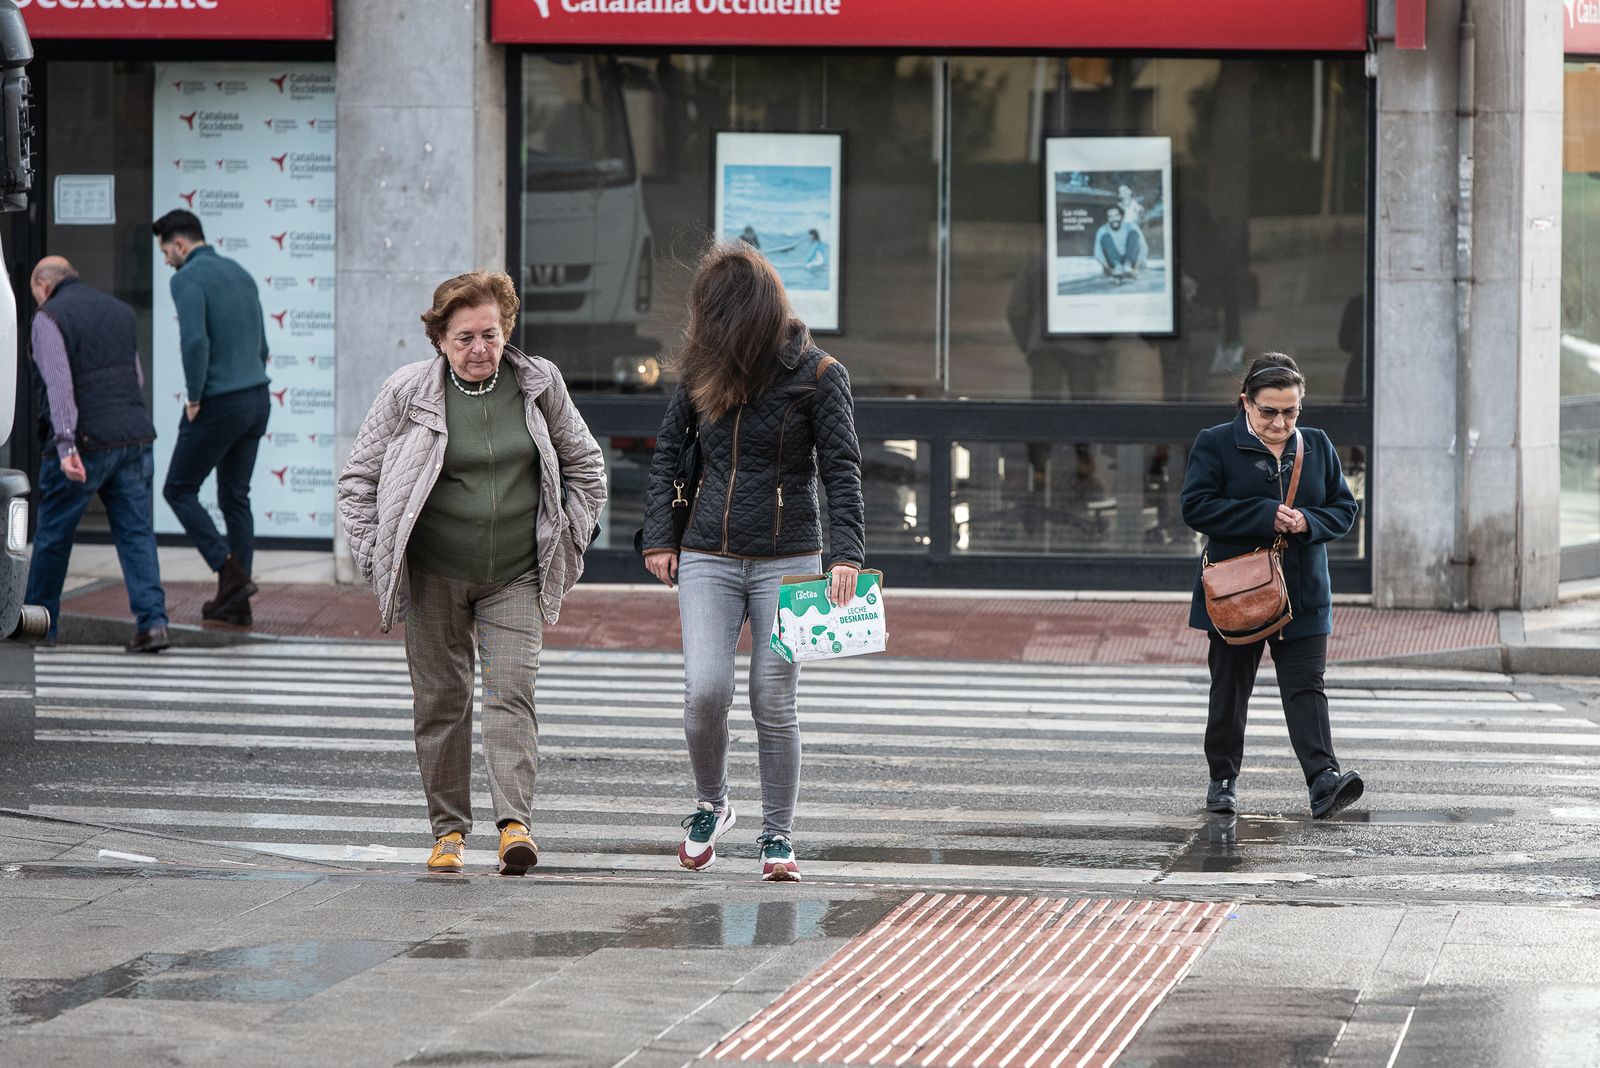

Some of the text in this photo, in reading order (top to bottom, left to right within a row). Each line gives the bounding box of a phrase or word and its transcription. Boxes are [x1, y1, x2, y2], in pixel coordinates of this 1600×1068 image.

[290, 73, 331, 83] Catalana
[199, 111, 240, 121] Catalana
[199, 122, 243, 131] Occidente
[290, 152, 331, 162] Catalana
[200, 189, 240, 199] Catalana
[200, 200, 244, 210] Occidente
[290, 231, 331, 241] Catalana
[847, 606, 867, 614] LECHE
[840, 612, 878, 624] DESNATADA
